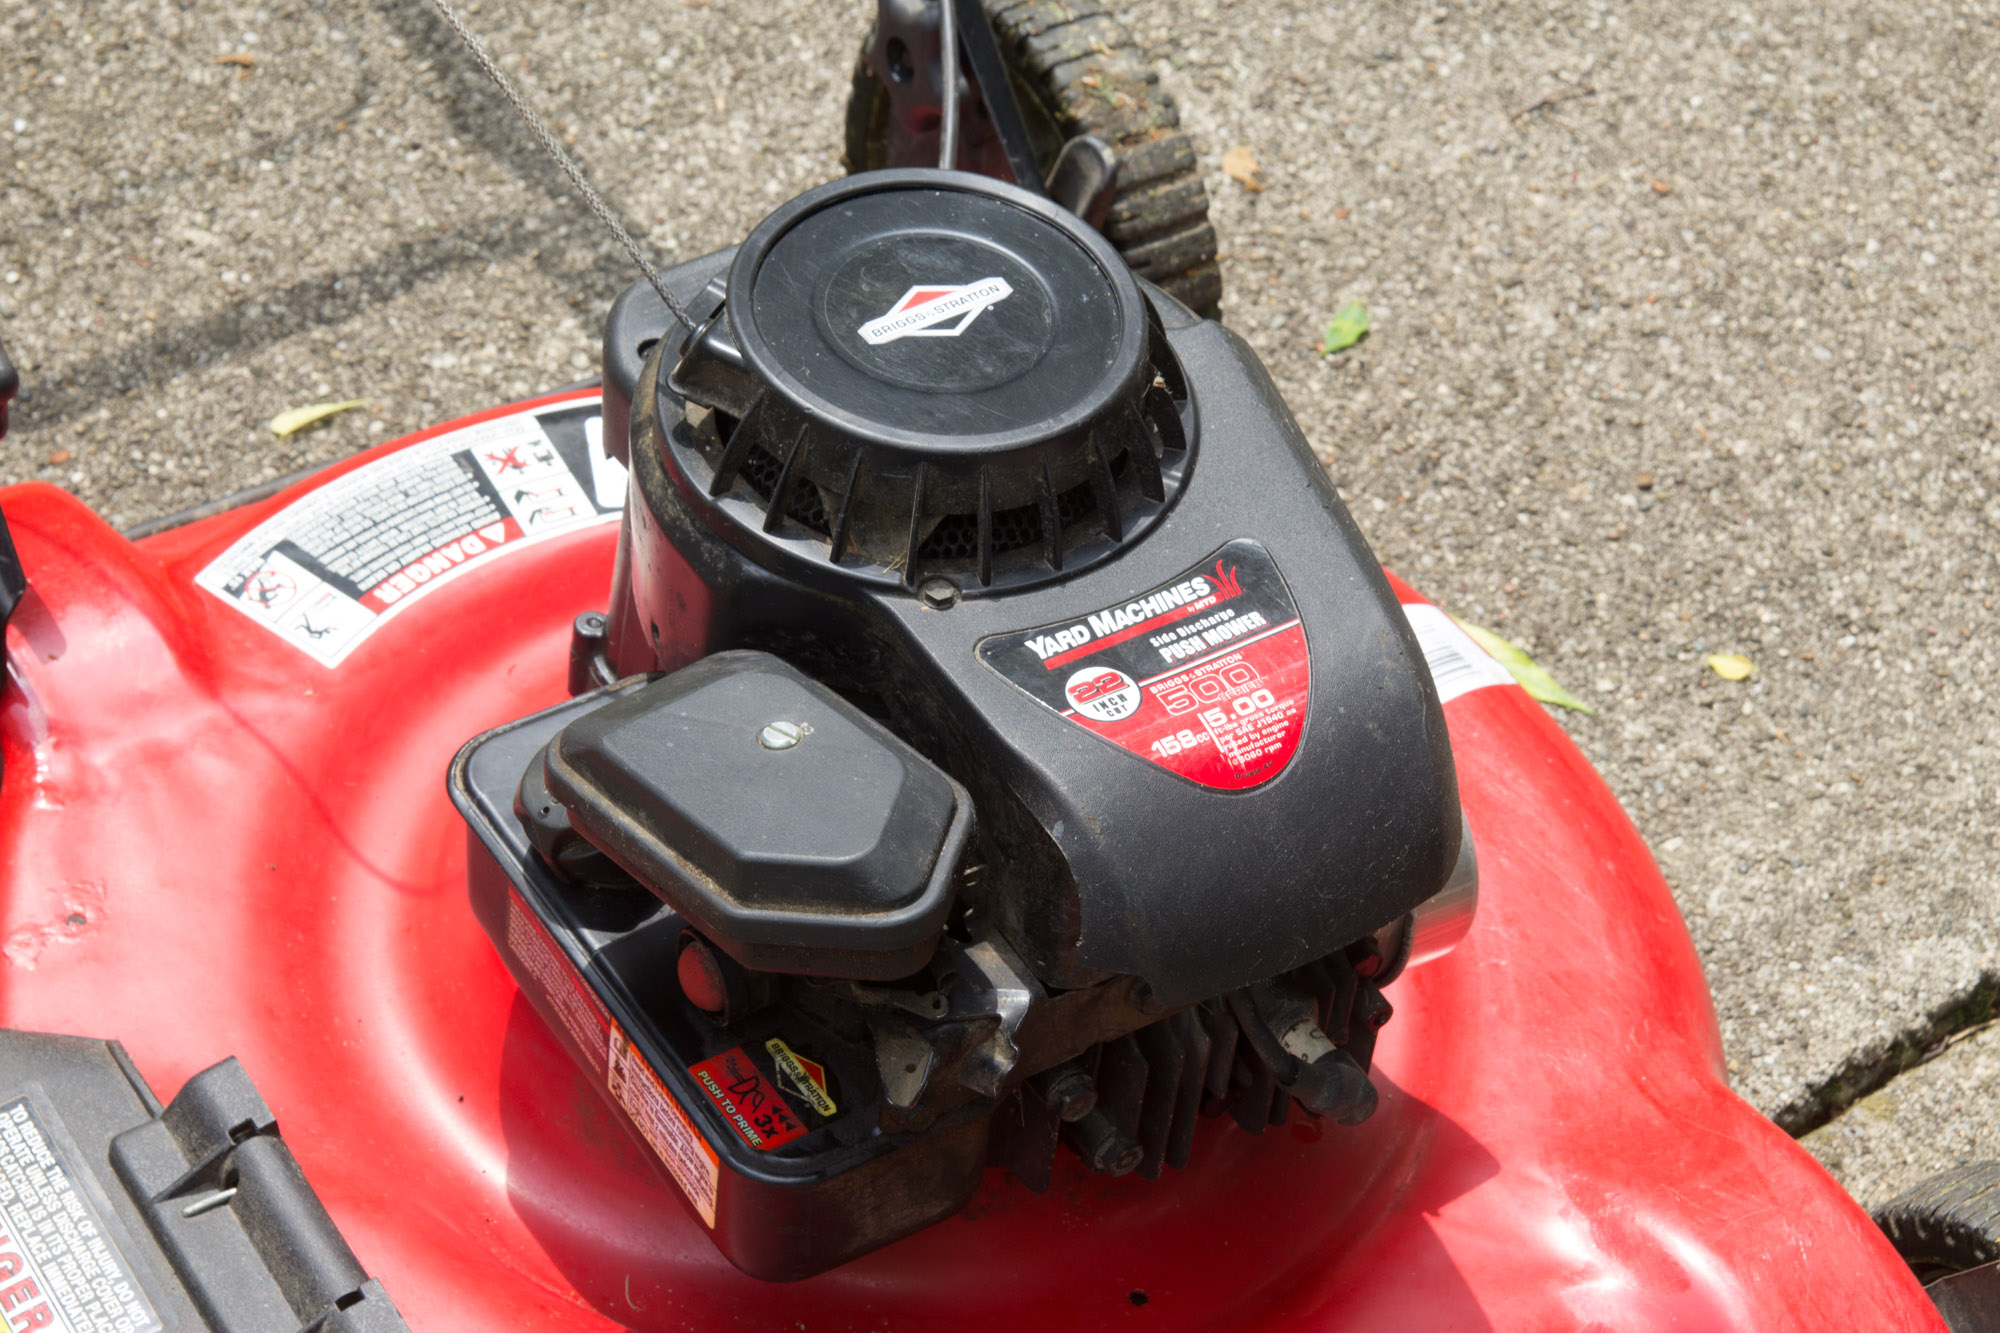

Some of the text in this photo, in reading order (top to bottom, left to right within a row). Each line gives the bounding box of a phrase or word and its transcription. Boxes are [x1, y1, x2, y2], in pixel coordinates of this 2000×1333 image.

[372, 533, 487, 604] DANGER
[1024, 577, 1210, 660] YARD MACHINES
[1187, 596, 1217, 613] by MTD
[1149, 608, 1235, 648] Side Discharge
[1159, 611, 1269, 664] PUSH MOWER
[1068, 671, 1130, 705] 22
[1092, 693, 1129, 713] INCH
[1156, 661, 1260, 715] 500
[1107, 705, 1129, 718] CUT
[1203, 688, 1275, 728] 5.00
[1214, 699, 1295, 736] ft-lbs gross torque
[1219, 707, 1297, 745] per SAE J1940 as
[1228, 730, 1287, 759] manufacturer
[1249, 731, 1261, 741] by
[1262, 720, 1290, 737] engine
[1264, 742, 1283, 754] rpm
[1263, 759, 1275, 770] AC
[697, 1070, 764, 1148] PUSH TO PRIME
[754, 1114, 779, 1140] 3x
[0, 1113, 35, 1167] OPERATE
[24, 1164, 61, 1212] UNLESS
[52, 1211, 101, 1278] DISCHARGE
[90, 1276, 123, 1318] COVER
[7, 1203, 51, 1262] REPLACE
[8, 1104, 148, 1329] TO REDUCE THE RISK OF INJURY, DO NOT
[0, 1155, 39, 1207] CATCHER
[30, 1206, 46, 1221] IS
[38, 1220, 53, 1235] IN
[46, 1233, 65, 1255] ITS
[56, 1254, 93, 1302] PROPER
[84, 1301, 117, 1333] PLAC
